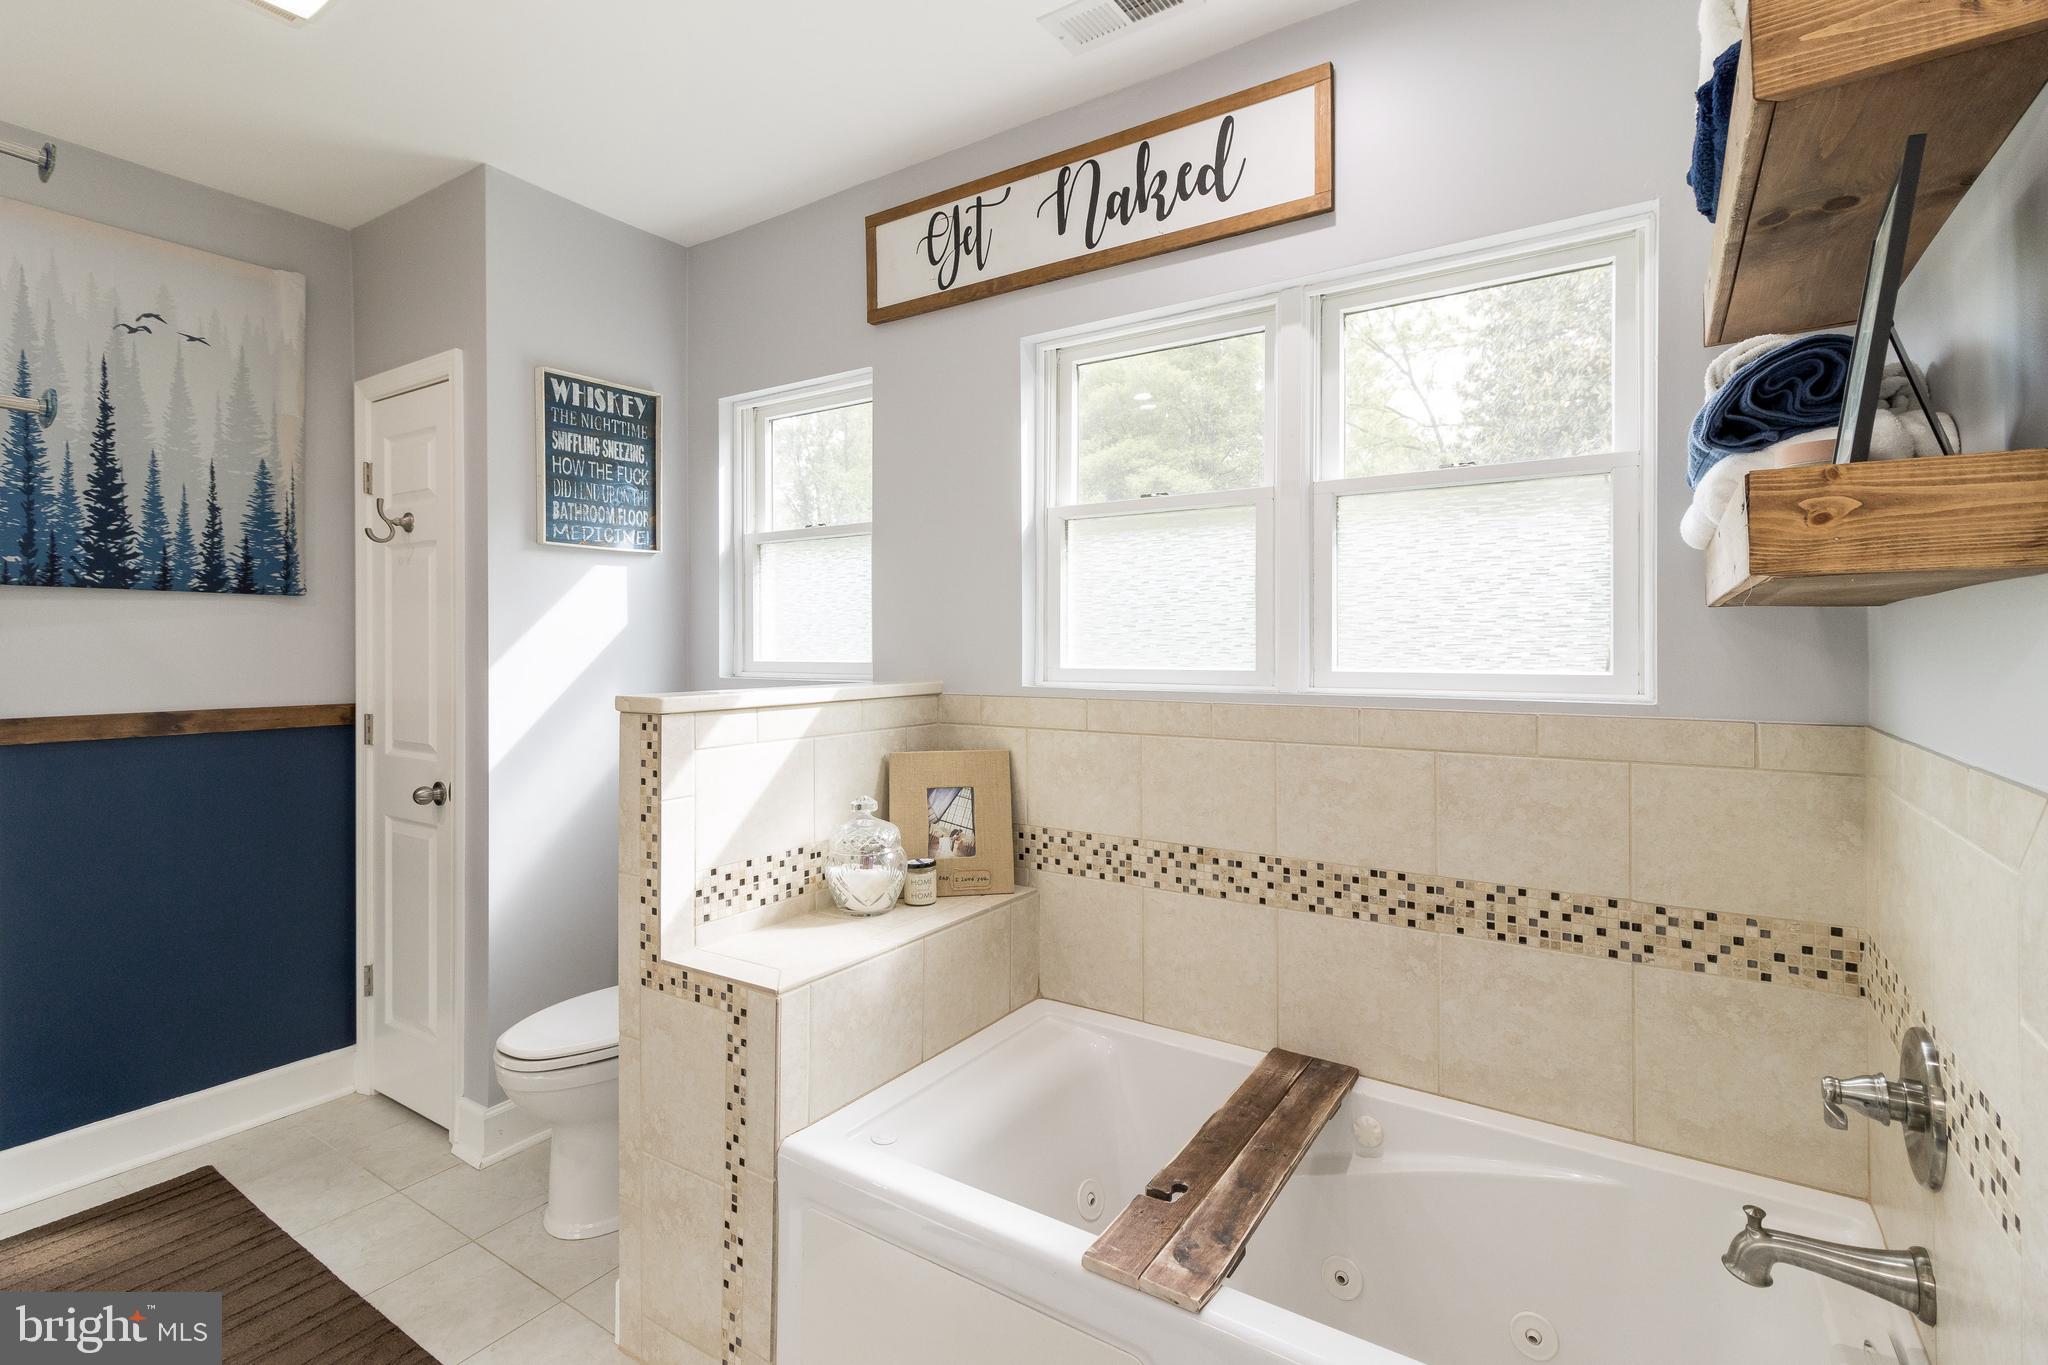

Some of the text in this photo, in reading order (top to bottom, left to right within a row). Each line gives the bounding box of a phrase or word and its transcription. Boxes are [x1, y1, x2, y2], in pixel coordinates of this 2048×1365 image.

[916, 115, 1246, 290] Get Naked
[550, 377, 648, 419] WHISKEY
[550, 406, 649, 440] THE NIGHTTIME
[552, 430, 649, 467] SNIFFLING SNEEZING,
[552, 455, 649, 485] HOW THE FUCK
[553, 478, 572, 498] DID
[574, 482, 577, 499] I
[580, 482, 600, 502] END
[602, 484, 615, 503] UP
[552, 500, 649, 527] BATHROOM FLOOR
[552, 523, 650, 546] MEDICINE!
[911, 877, 932, 886] HOME
[911, 891, 932, 900] HOME
